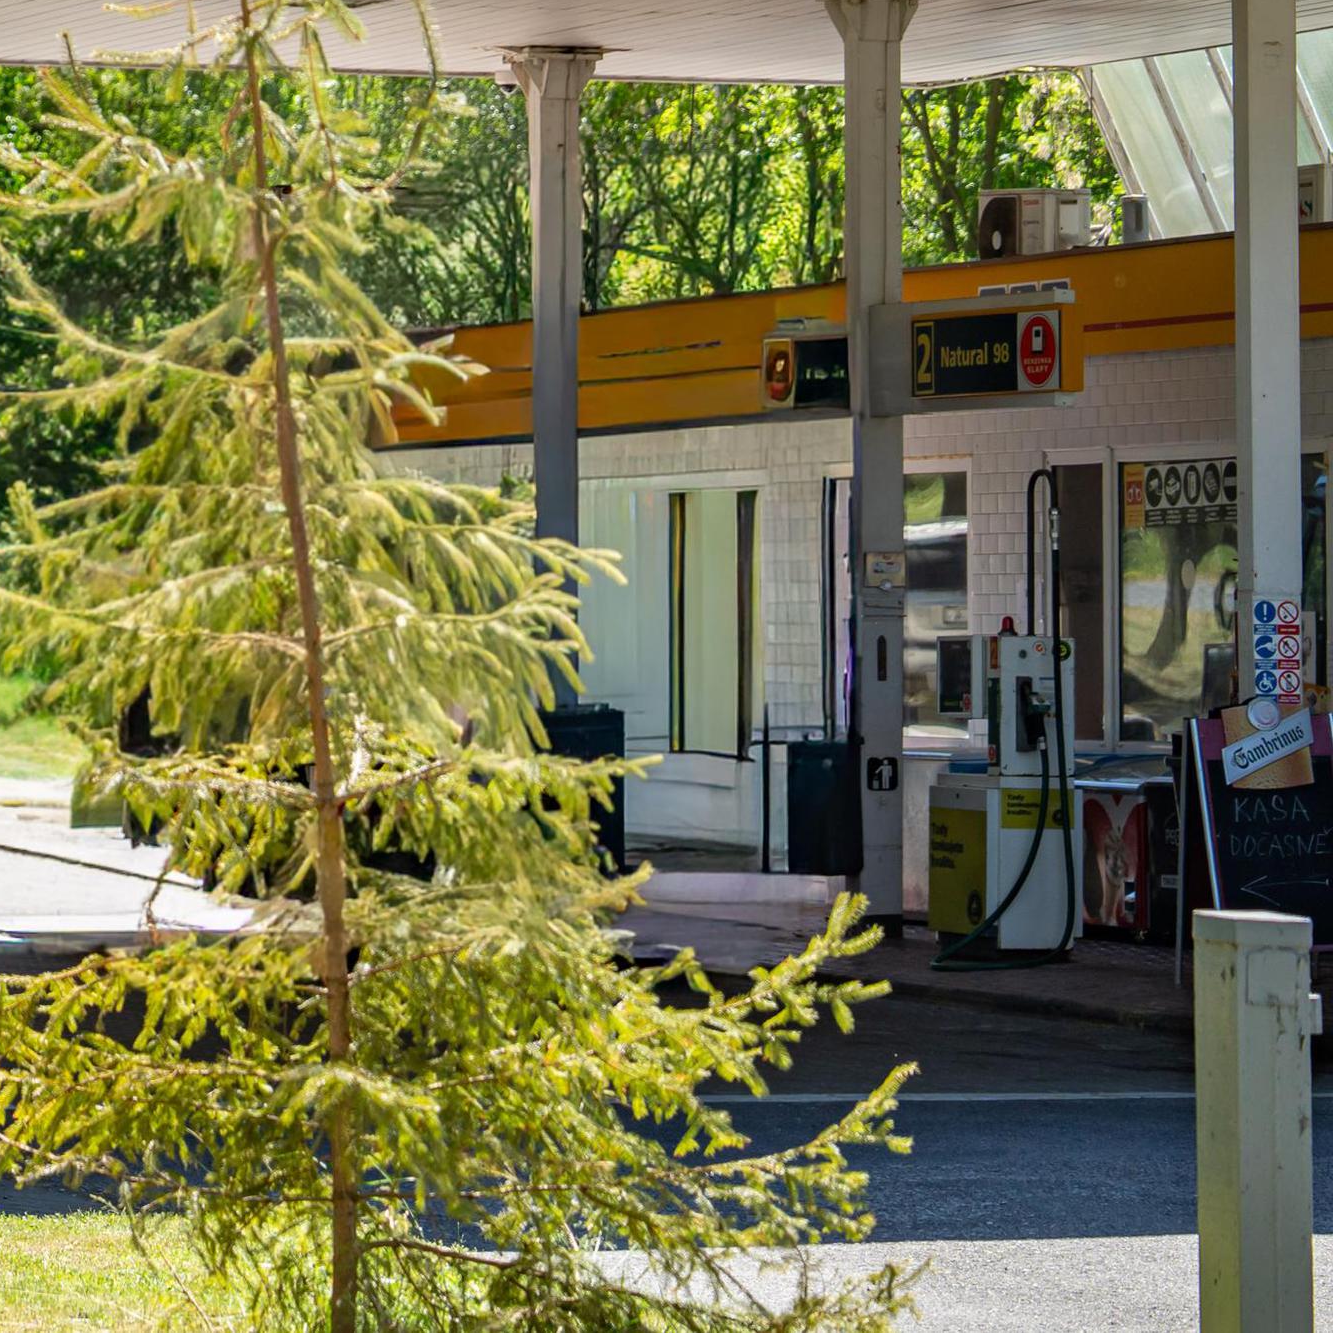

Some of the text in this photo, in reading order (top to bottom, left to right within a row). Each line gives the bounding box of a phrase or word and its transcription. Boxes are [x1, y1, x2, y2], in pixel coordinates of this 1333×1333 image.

[917, 333, 1010, 383] 2 Natural 98
[1233, 725, 1305, 769] Gambrinus
[1234, 794, 1310, 824] KASA
